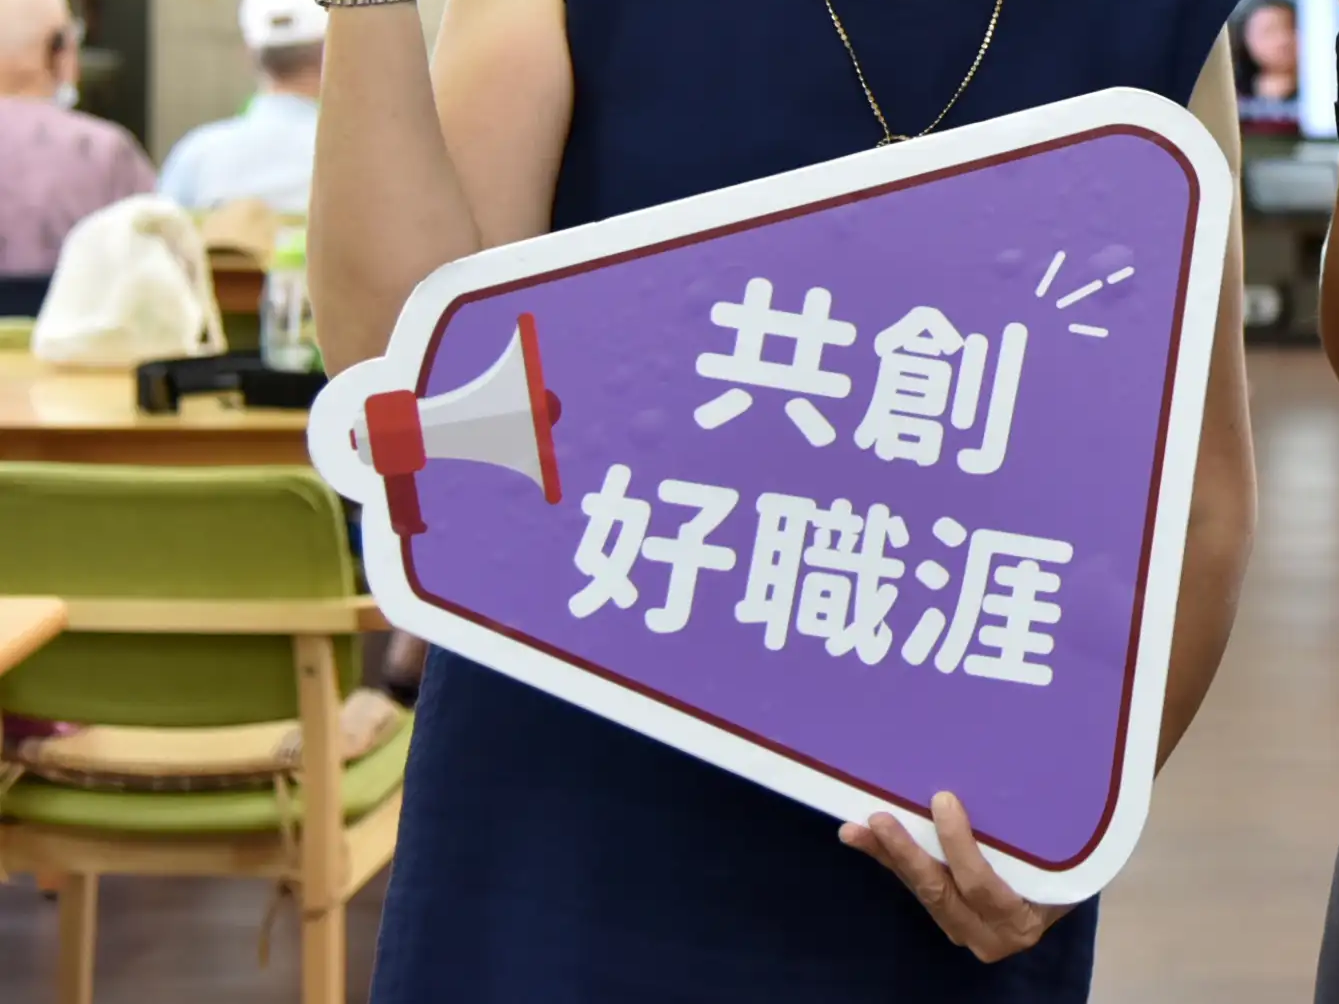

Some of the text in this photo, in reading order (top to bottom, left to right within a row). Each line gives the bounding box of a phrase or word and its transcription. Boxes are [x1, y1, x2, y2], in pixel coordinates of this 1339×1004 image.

[693, 277, 1028, 475] 共創
[567, 463, 1074, 686] 好職涯
